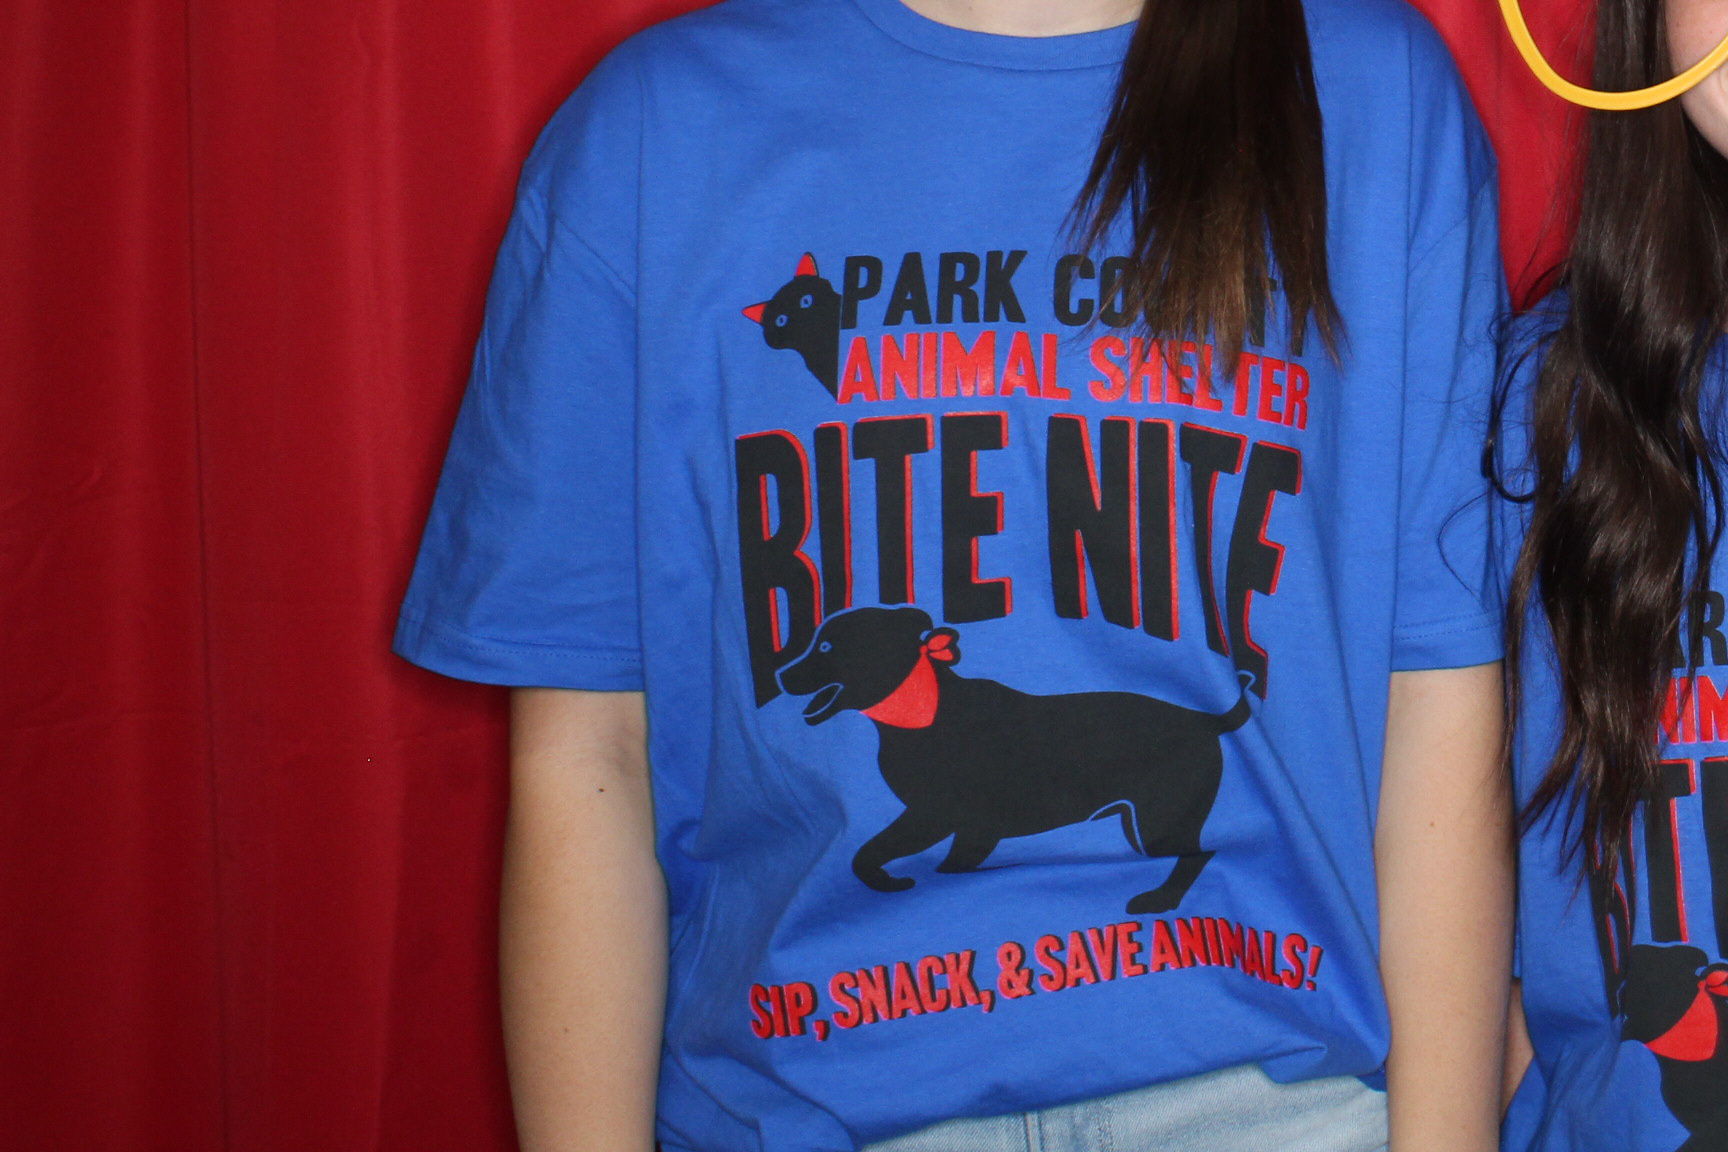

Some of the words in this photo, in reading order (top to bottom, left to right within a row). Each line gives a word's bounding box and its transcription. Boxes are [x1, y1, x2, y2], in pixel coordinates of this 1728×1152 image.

[842, 251, 1027, 329] PARK
[838, 330, 1071, 405] ANIMAL
[1088, 334, 1310, 431] SHELTER
[734, 410, 1013, 710] BITE
[1045, 412, 1302, 701] NITE
[749, 980, 830, 1041] SIP,
[828, 949, 996, 1029] SNACK,
[996, 940, 1039, 1000] &
[1034, 920, 1146, 994] SAVE
[1149, 915, 1325, 992] ANIMALS!
